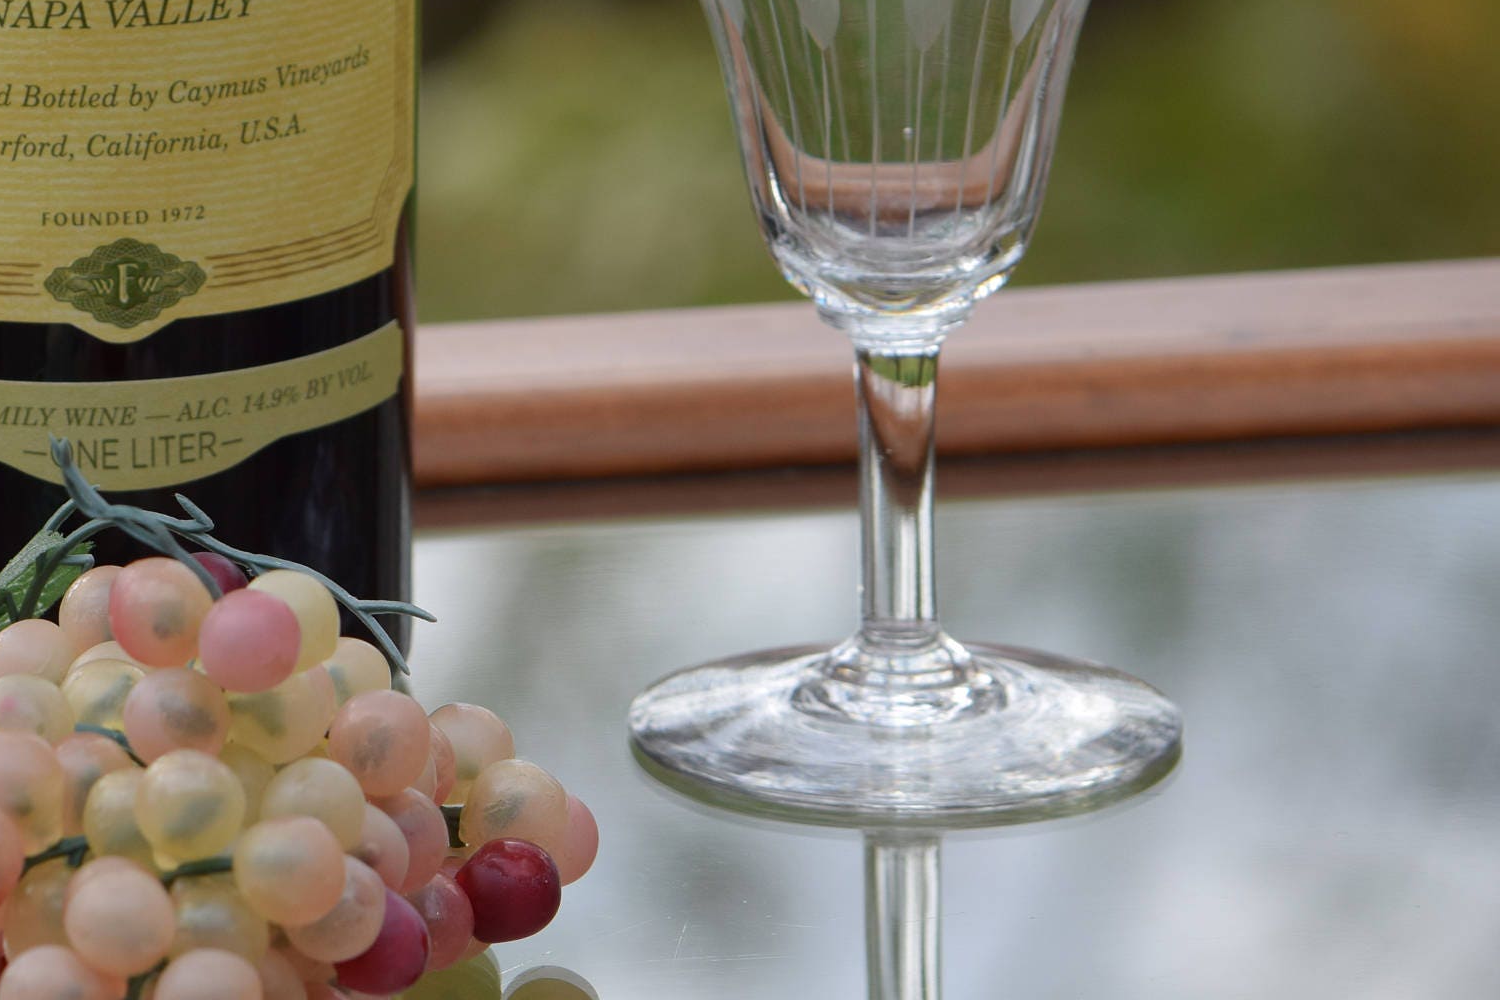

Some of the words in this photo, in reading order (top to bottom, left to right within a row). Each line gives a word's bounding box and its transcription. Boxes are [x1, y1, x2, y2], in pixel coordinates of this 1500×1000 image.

[21, 83, 118, 109] Bottled
[128, 81, 159, 109] by
[167, 74, 268, 107] Caymus
[276, 44, 371, 90] Vineyards
[86, 130, 230, 160] California,
[41, 209, 150, 227] FOUNDED
[160, 204, 206, 223] 1972
[64, 406, 137, 427] WINE
[177, 396, 232, 423] ALC.
[241, 385, 300, 415] 14.9%
[305, 374, 334, 401] BY
